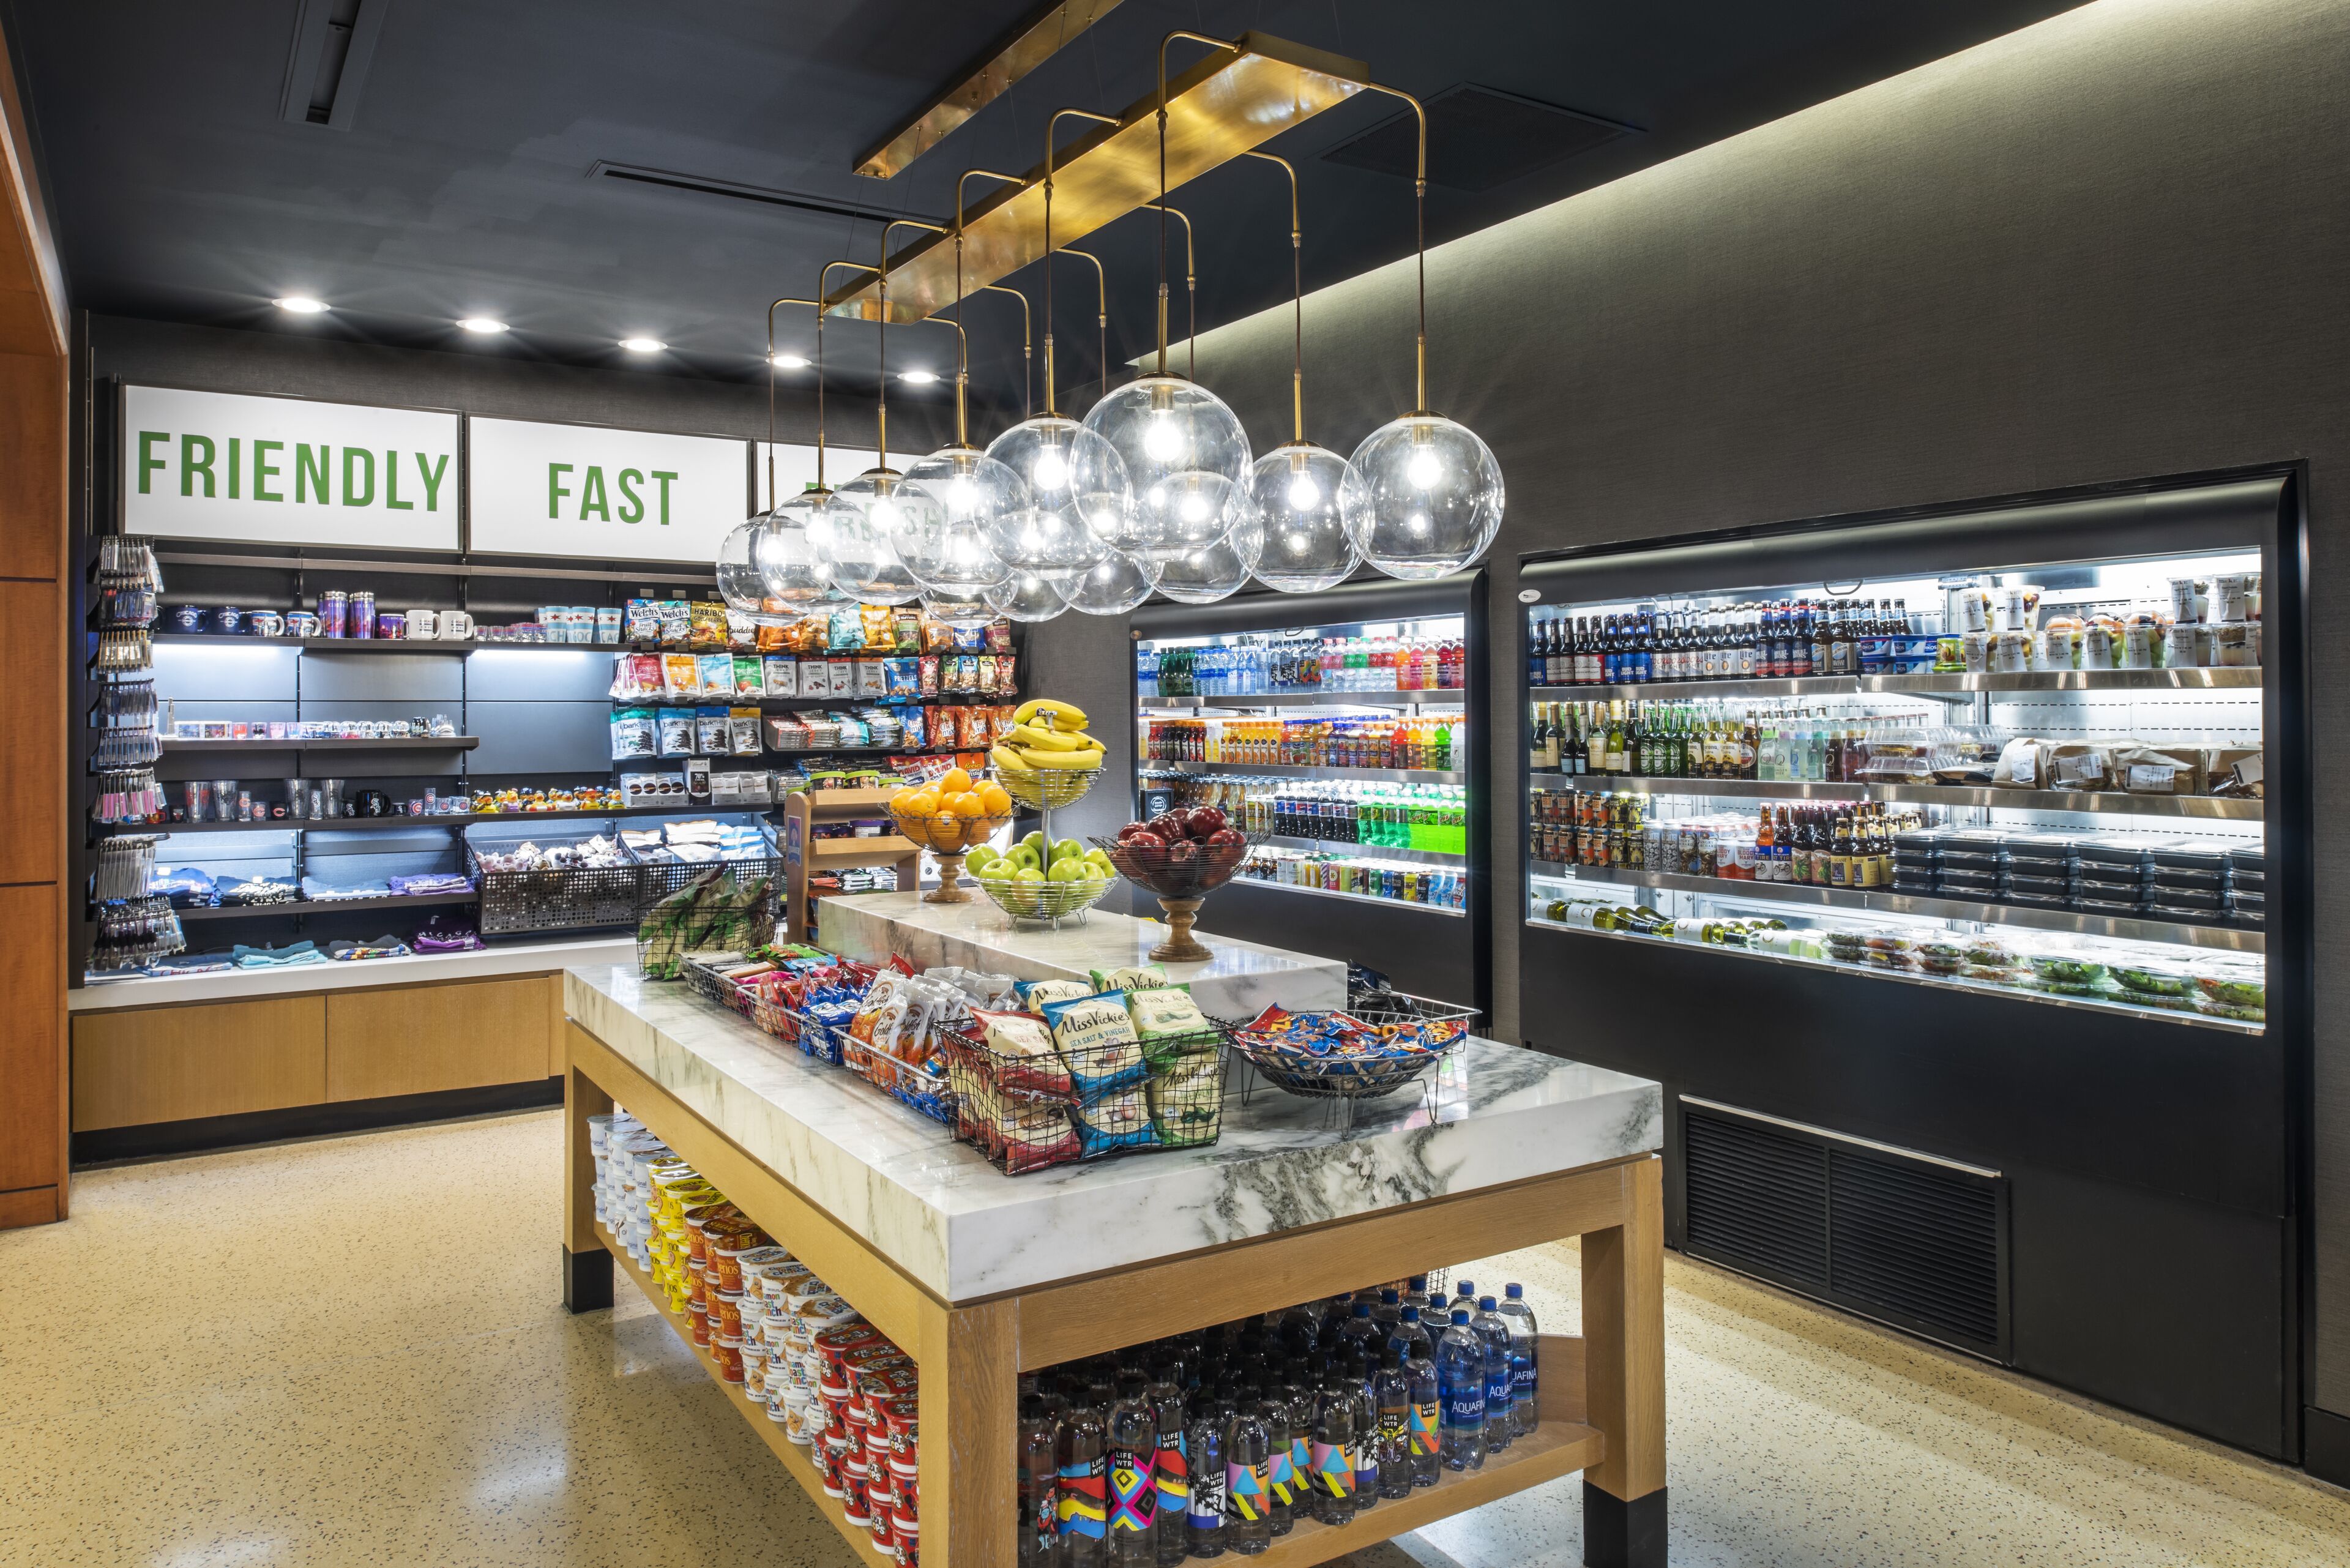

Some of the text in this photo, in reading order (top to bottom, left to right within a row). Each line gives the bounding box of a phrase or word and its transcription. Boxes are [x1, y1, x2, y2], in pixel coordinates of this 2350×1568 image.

[138, 431, 449, 512] FRIENDLY
[549, 463, 678, 525] FAST
[631, 607, 658, 618] Welch's
[662, 608, 688, 619] Welch's
[694, 608, 722, 617] HARIBO
[1704, 653, 1716, 662] Lite
[1720, 652, 1731, 660] Lite
[1740, 651, 1753, 659] Lite
[898, 765, 920, 775] DAVID
[928, 764, 952, 777] DAVID
[1105, 979, 1133, 991] Miss
[1061, 1017, 1092, 1036] Miss
[1087, 1009, 1130, 1026] Vickie's
[1083, 1036, 1096, 1045] SALT
[1104, 1026, 1131, 1038] VINEGAR
[1163, 1432, 1178, 1441] LIFE
[1092, 1457, 1103, 1468] LIFE
[1257, 1460, 1268, 1469] LIFE
[1210, 1471, 1223, 1480] LIFE
[1257, 1468, 1269, 1476] WTR
[1210, 1478, 1223, 1487] WTR
